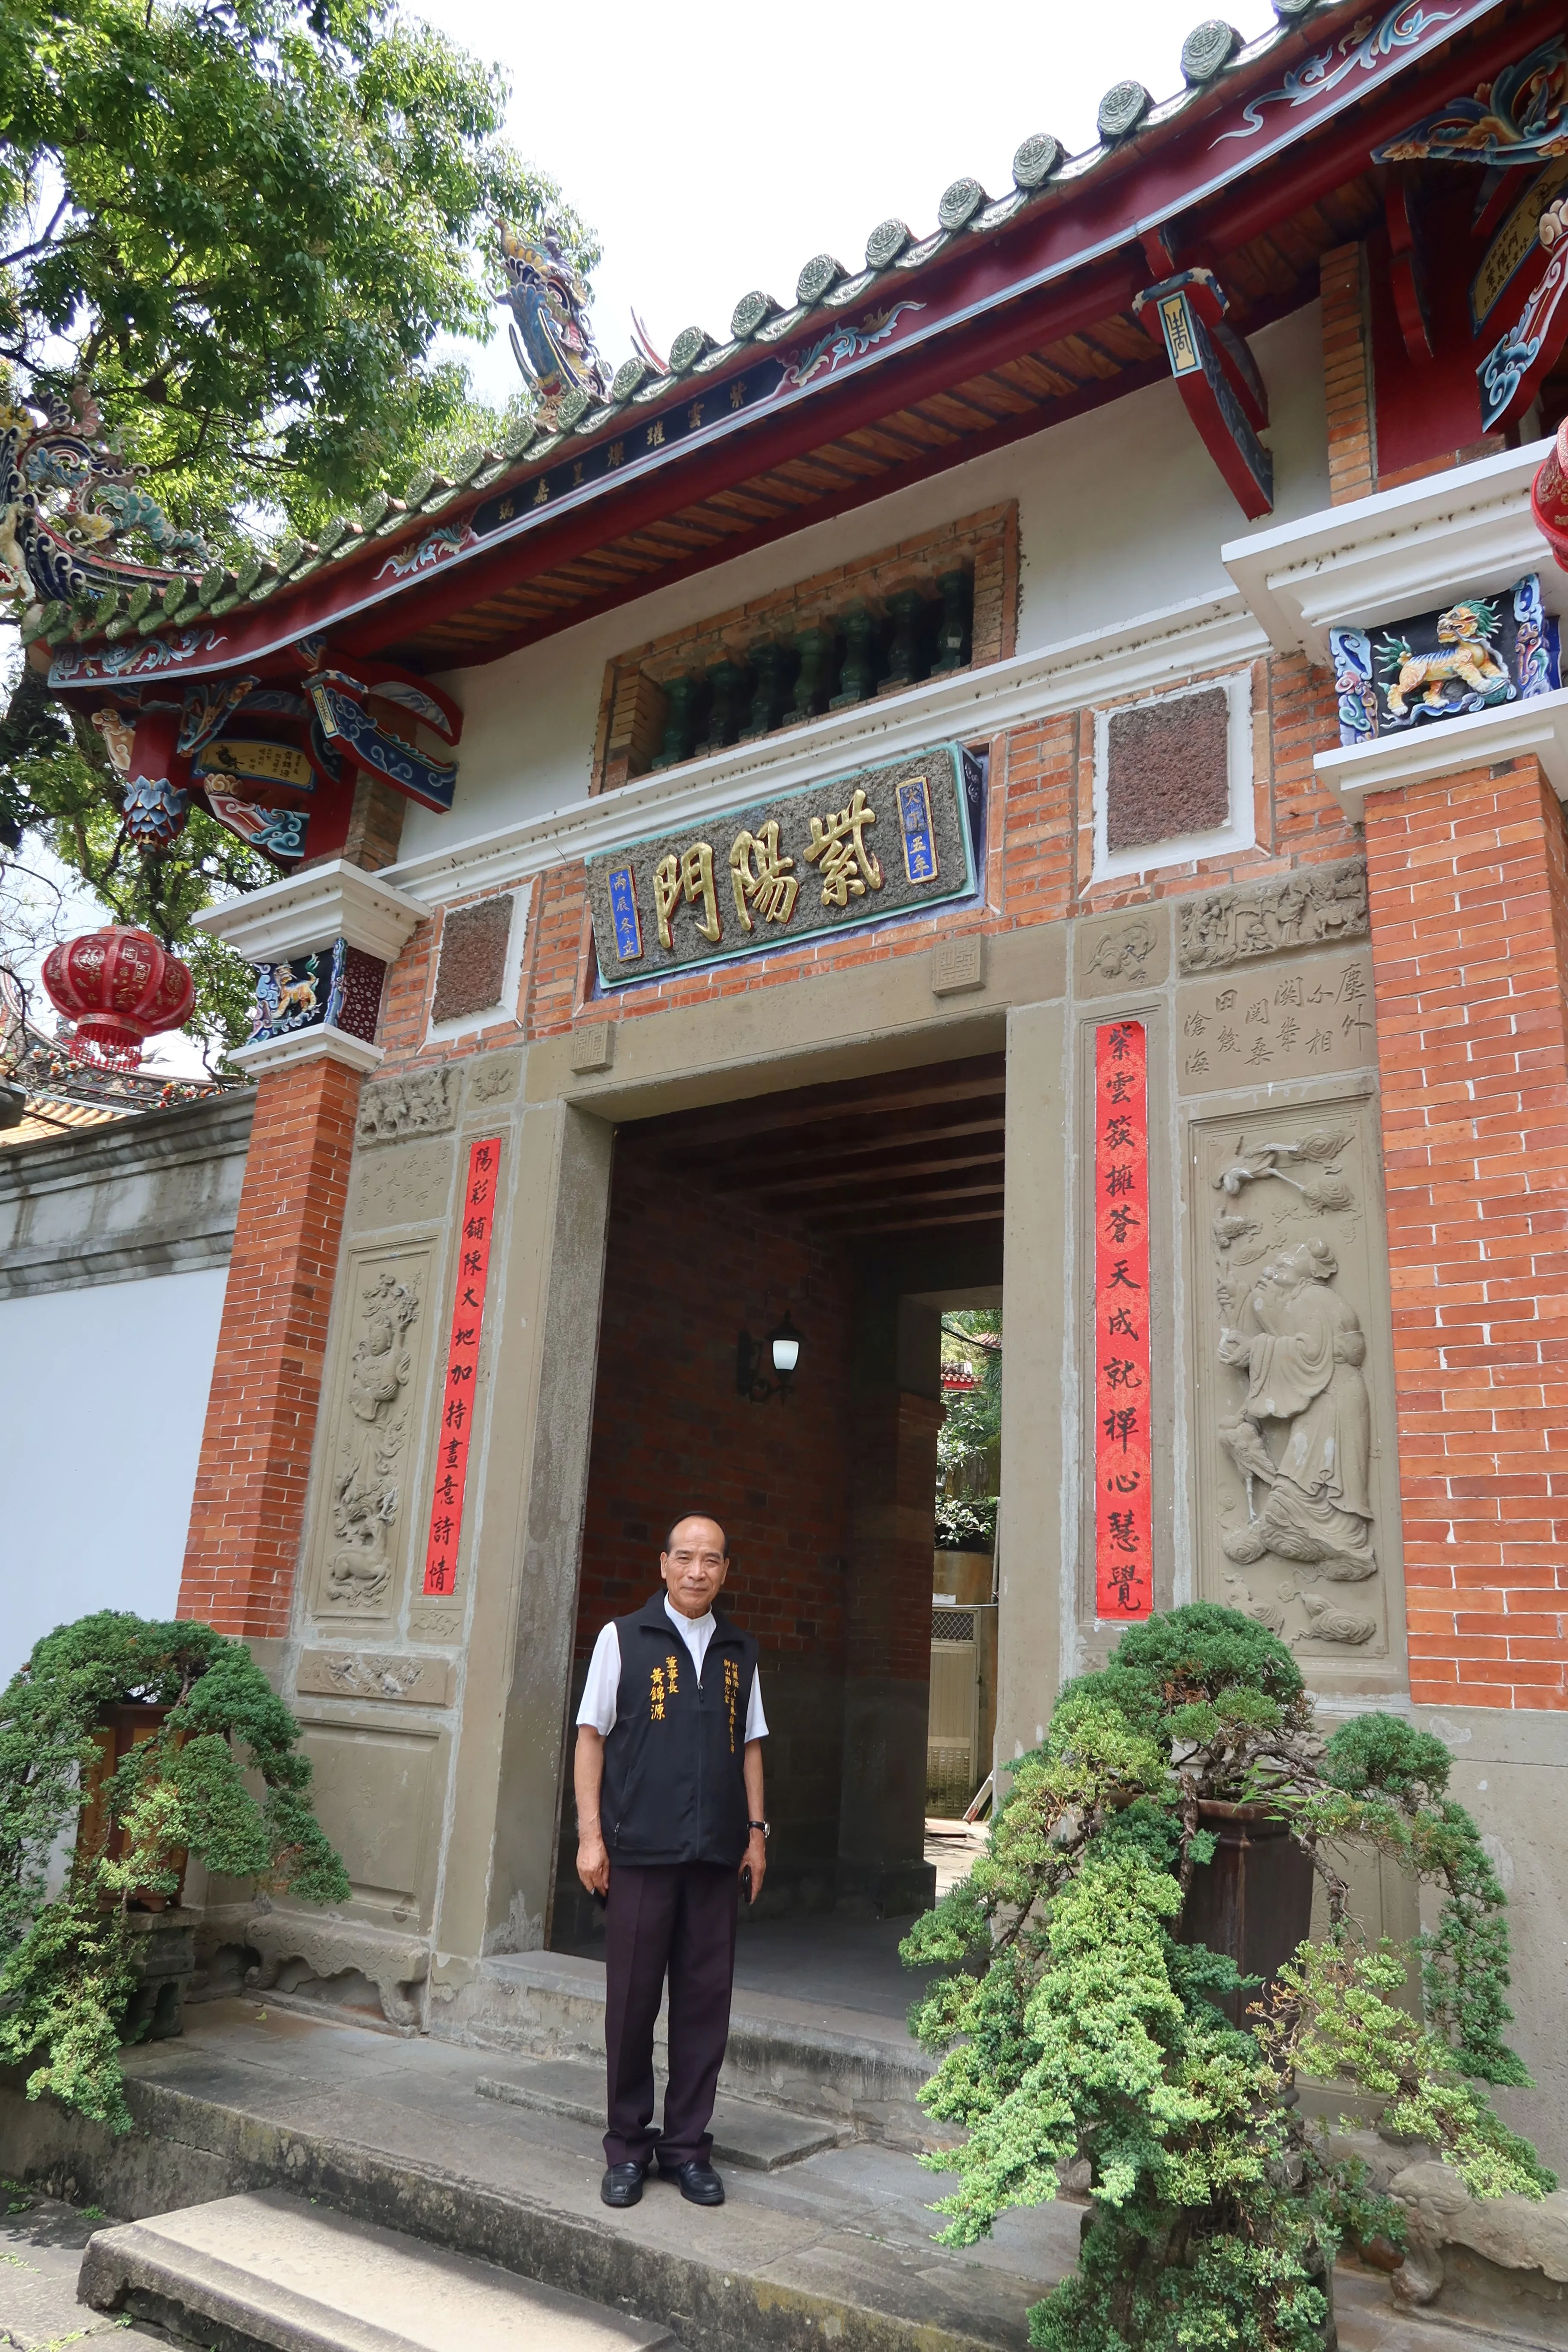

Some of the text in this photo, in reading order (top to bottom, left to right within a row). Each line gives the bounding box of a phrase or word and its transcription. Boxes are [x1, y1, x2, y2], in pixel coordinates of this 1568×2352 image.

[652, 789, 884, 949] 紫陽門
[613, 875, 635, 956] 丙辰冬立
[649, 1668, 665, 1720] 黃錦源
[665, 1656, 680, 1694] 董事長
